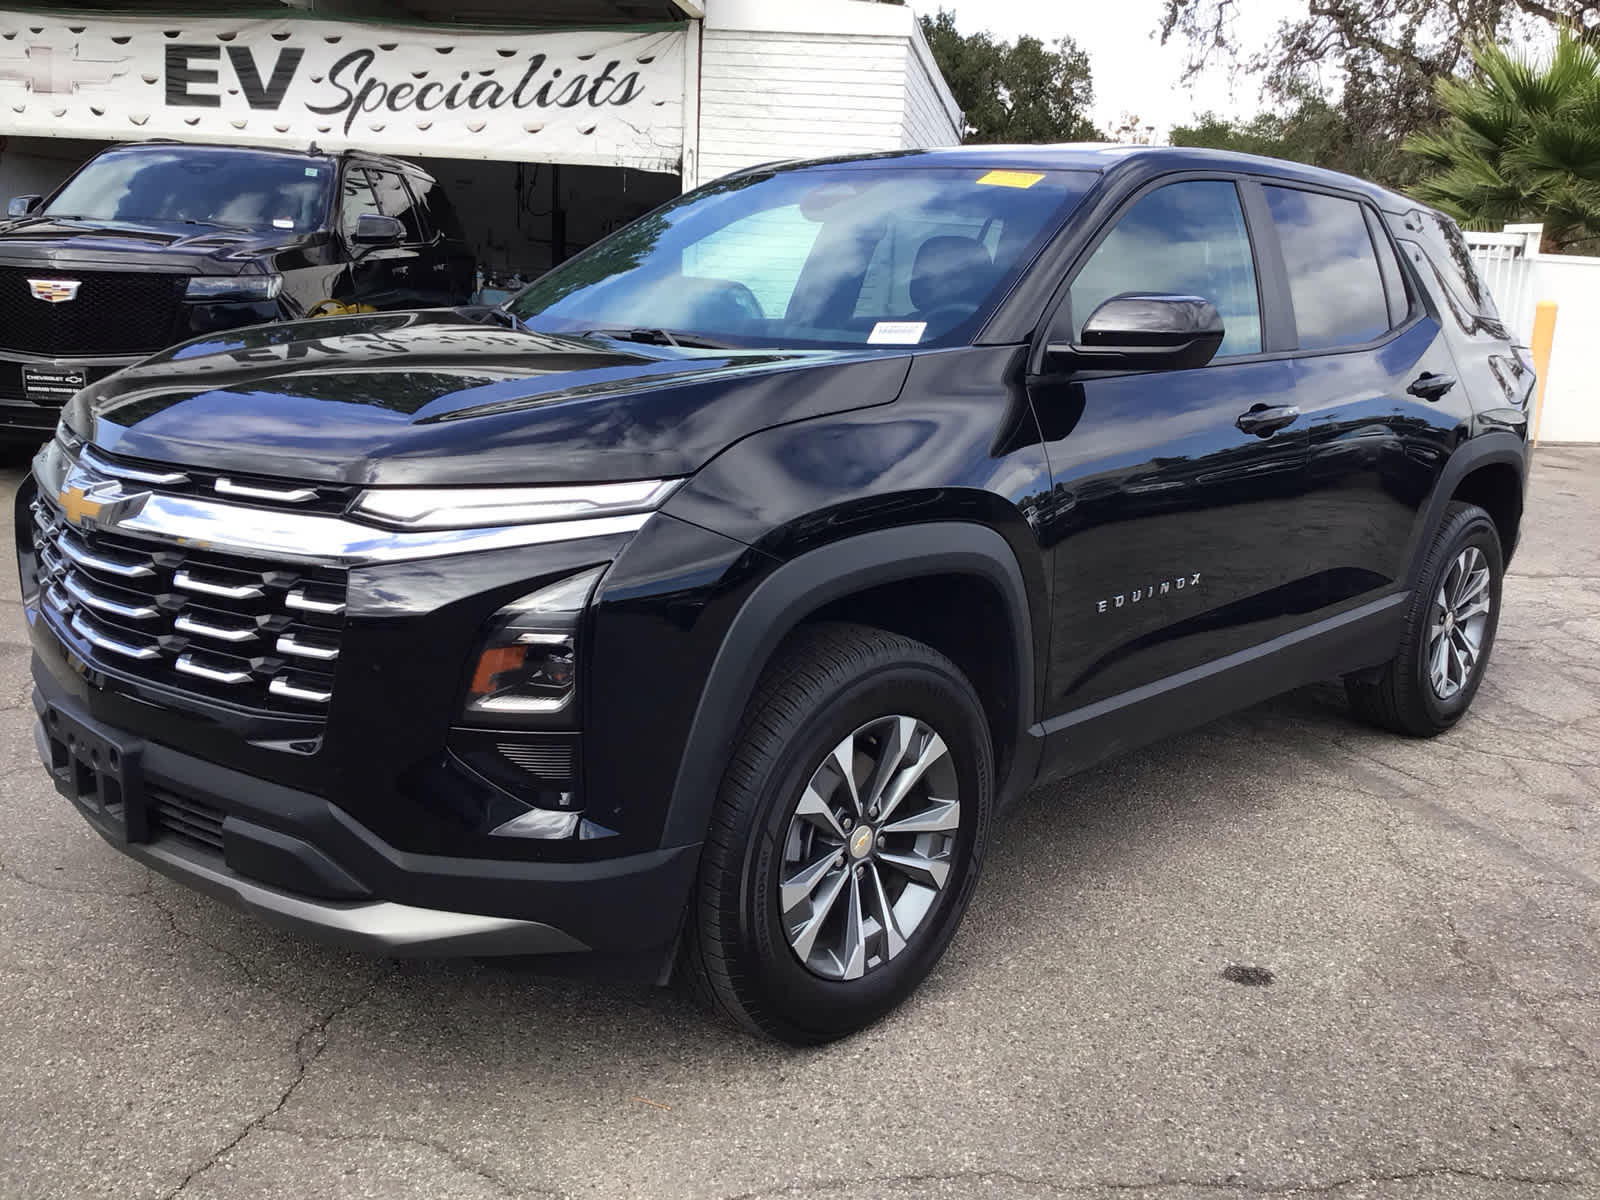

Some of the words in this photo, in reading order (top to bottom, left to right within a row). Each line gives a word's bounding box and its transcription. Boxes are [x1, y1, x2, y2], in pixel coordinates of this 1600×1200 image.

[165, 43, 305, 109] EV
[304, 48, 646, 136] Specialists
[1097, 573, 1201, 613] EQUINOX
